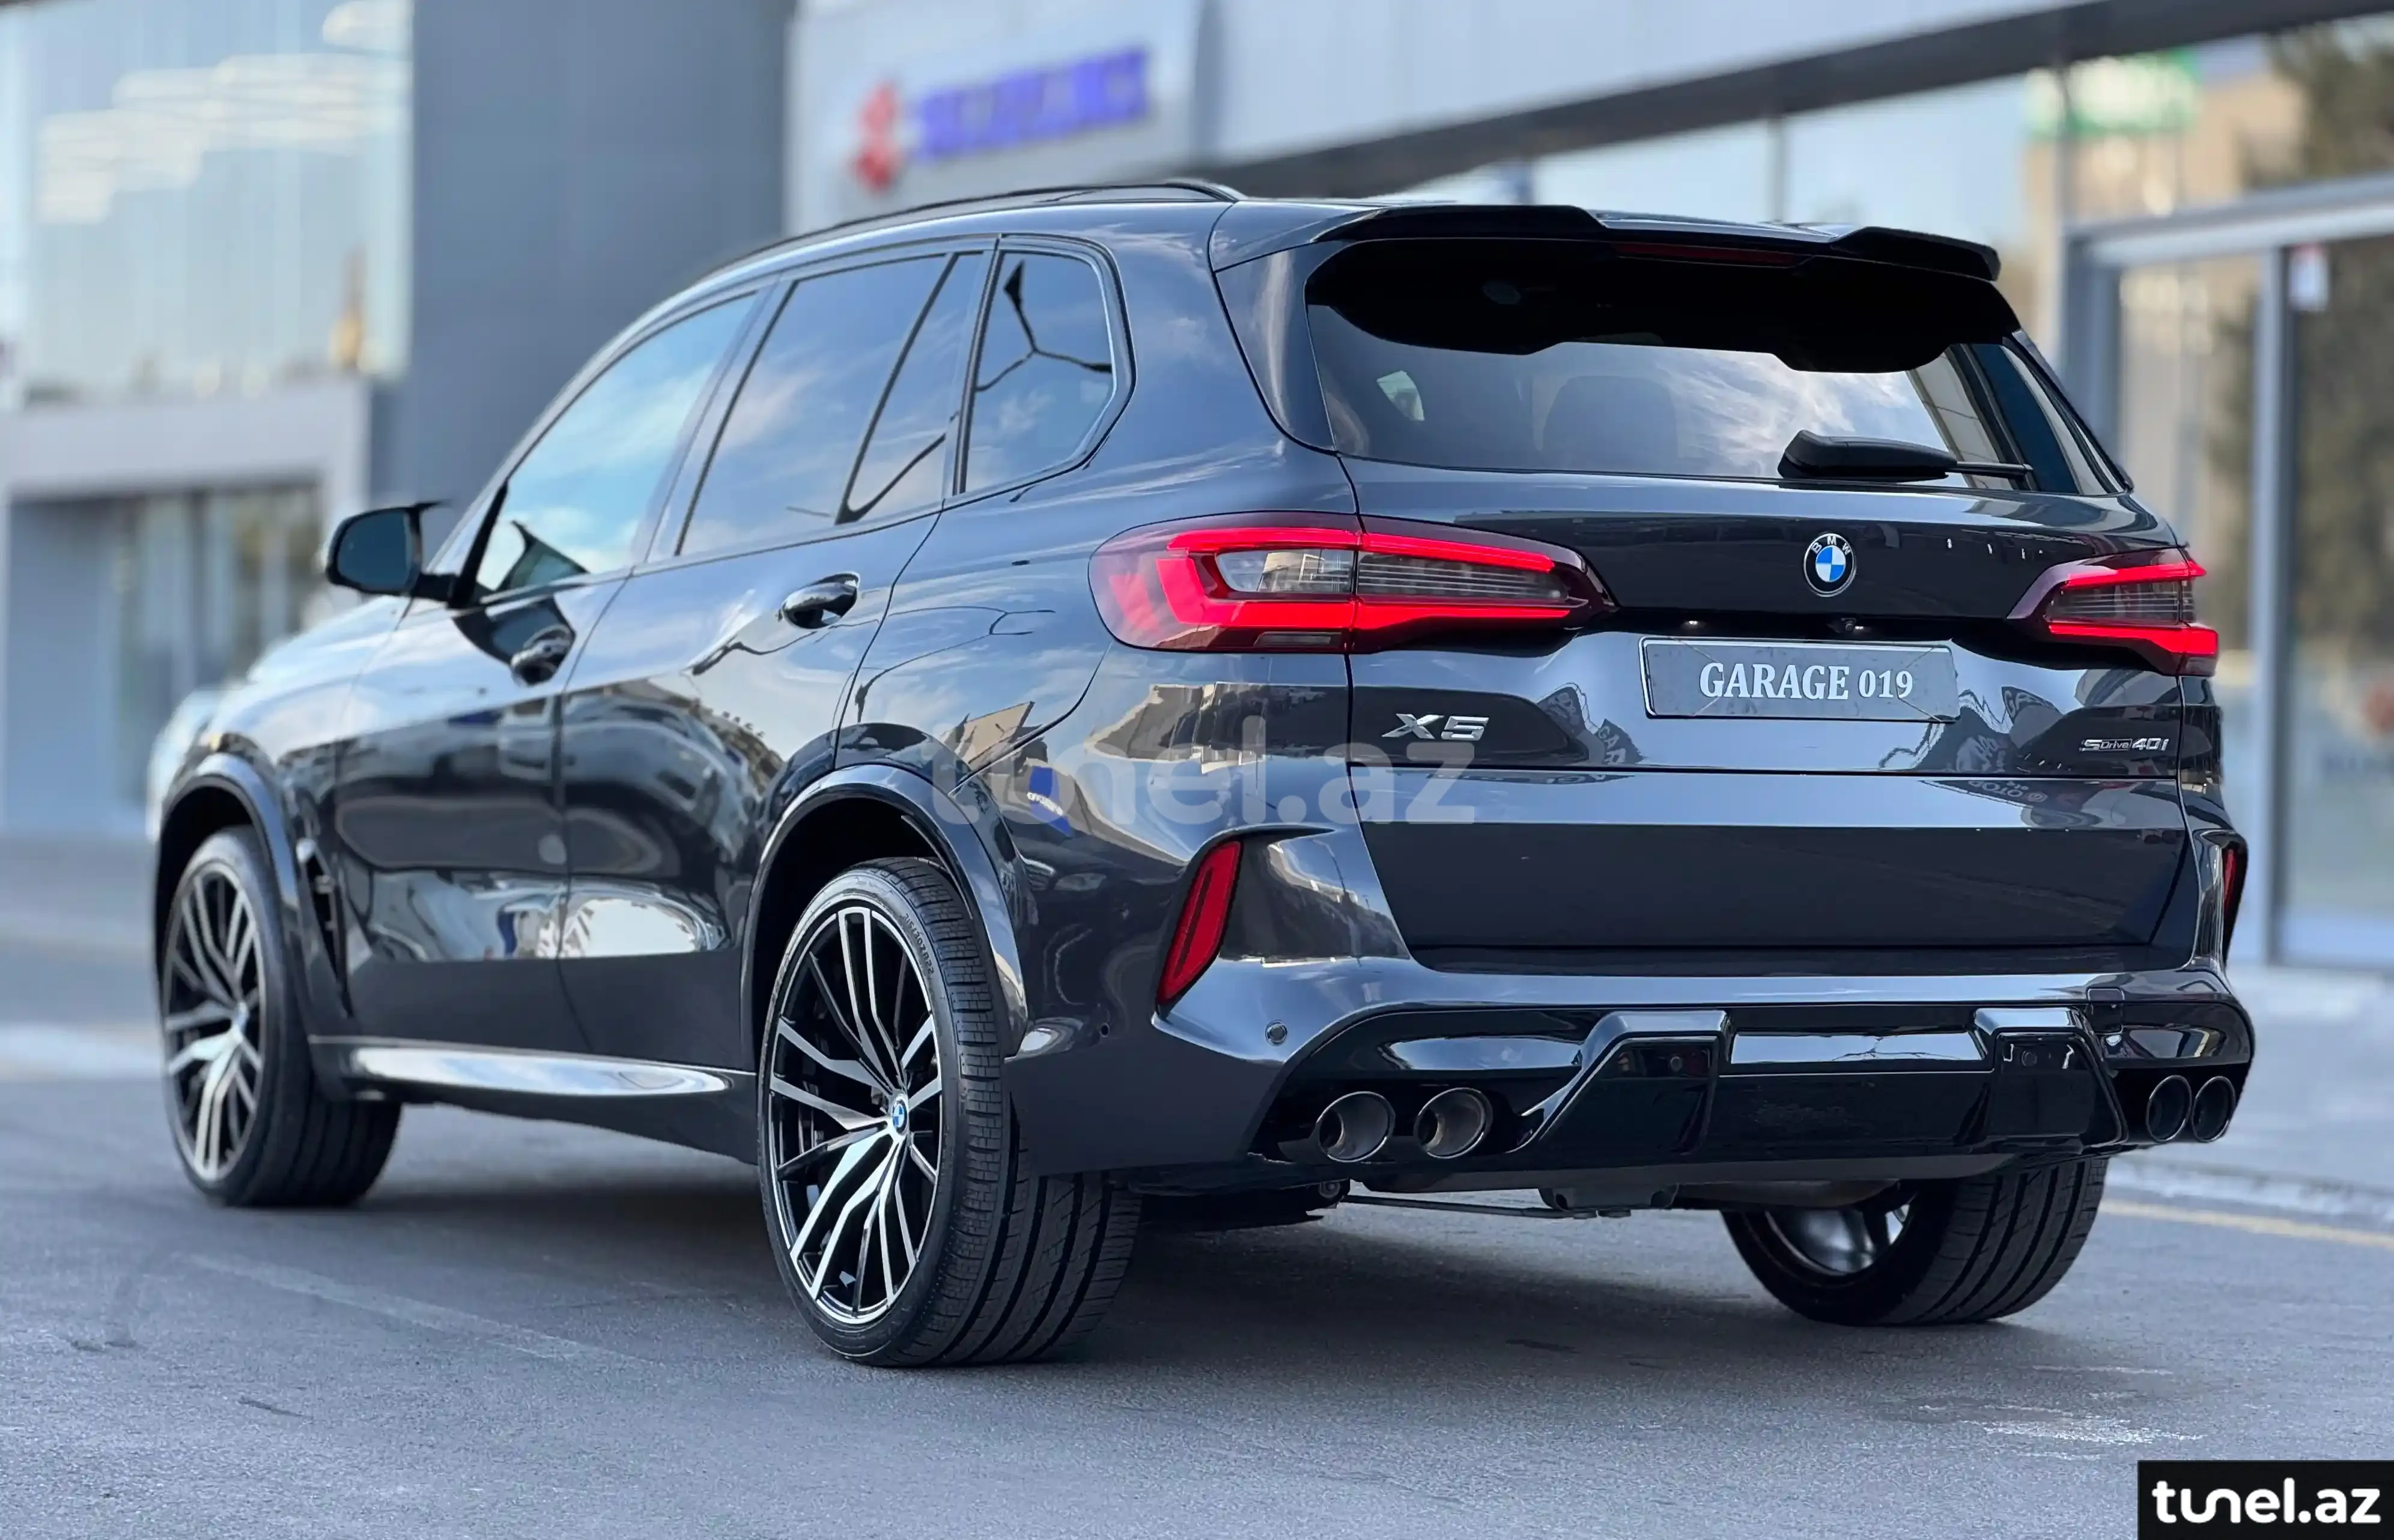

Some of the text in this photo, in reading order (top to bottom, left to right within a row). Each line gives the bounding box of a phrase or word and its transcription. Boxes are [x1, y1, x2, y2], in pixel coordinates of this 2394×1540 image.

[1811, 536, 1851, 555] BMW
[1699, 662, 1913, 700] GARAGE 019
[1382, 713, 1490, 741] X5
